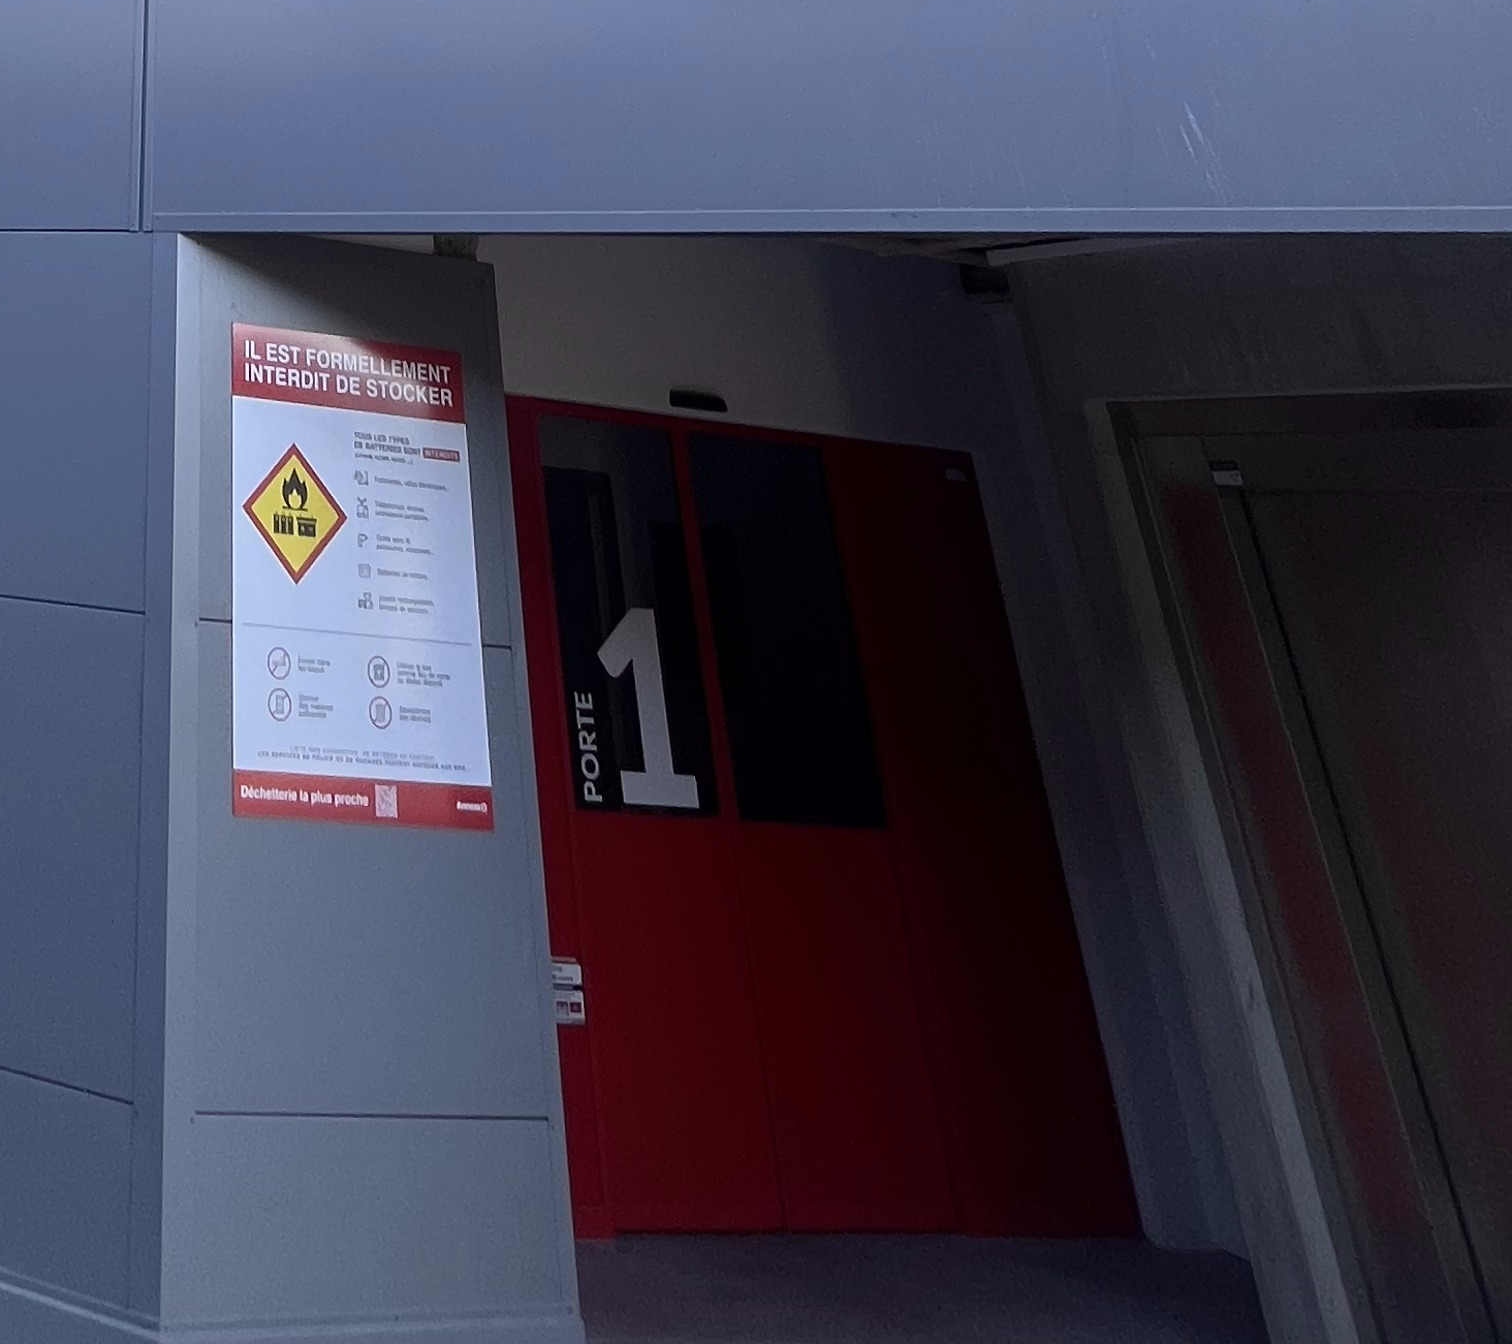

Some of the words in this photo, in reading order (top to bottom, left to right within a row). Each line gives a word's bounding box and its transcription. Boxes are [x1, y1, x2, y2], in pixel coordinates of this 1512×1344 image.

[244, 339, 262, 361] IL
[265, 342, 302, 365] EST
[305, 348, 452, 385] FORMELLEMENT
[244, 362, 331, 392] INTERDIT
[336, 374, 362, 396] DE
[366, 379, 454, 408] STOCKER
[597, 607, 700, 809] 1
[574, 691, 603, 803] PORTE
[240, 784, 298, 803] Déchetterie
[299, 788, 309, 803] la
[310, 789, 332, 807] plus
[334, 789, 369, 808] proche
